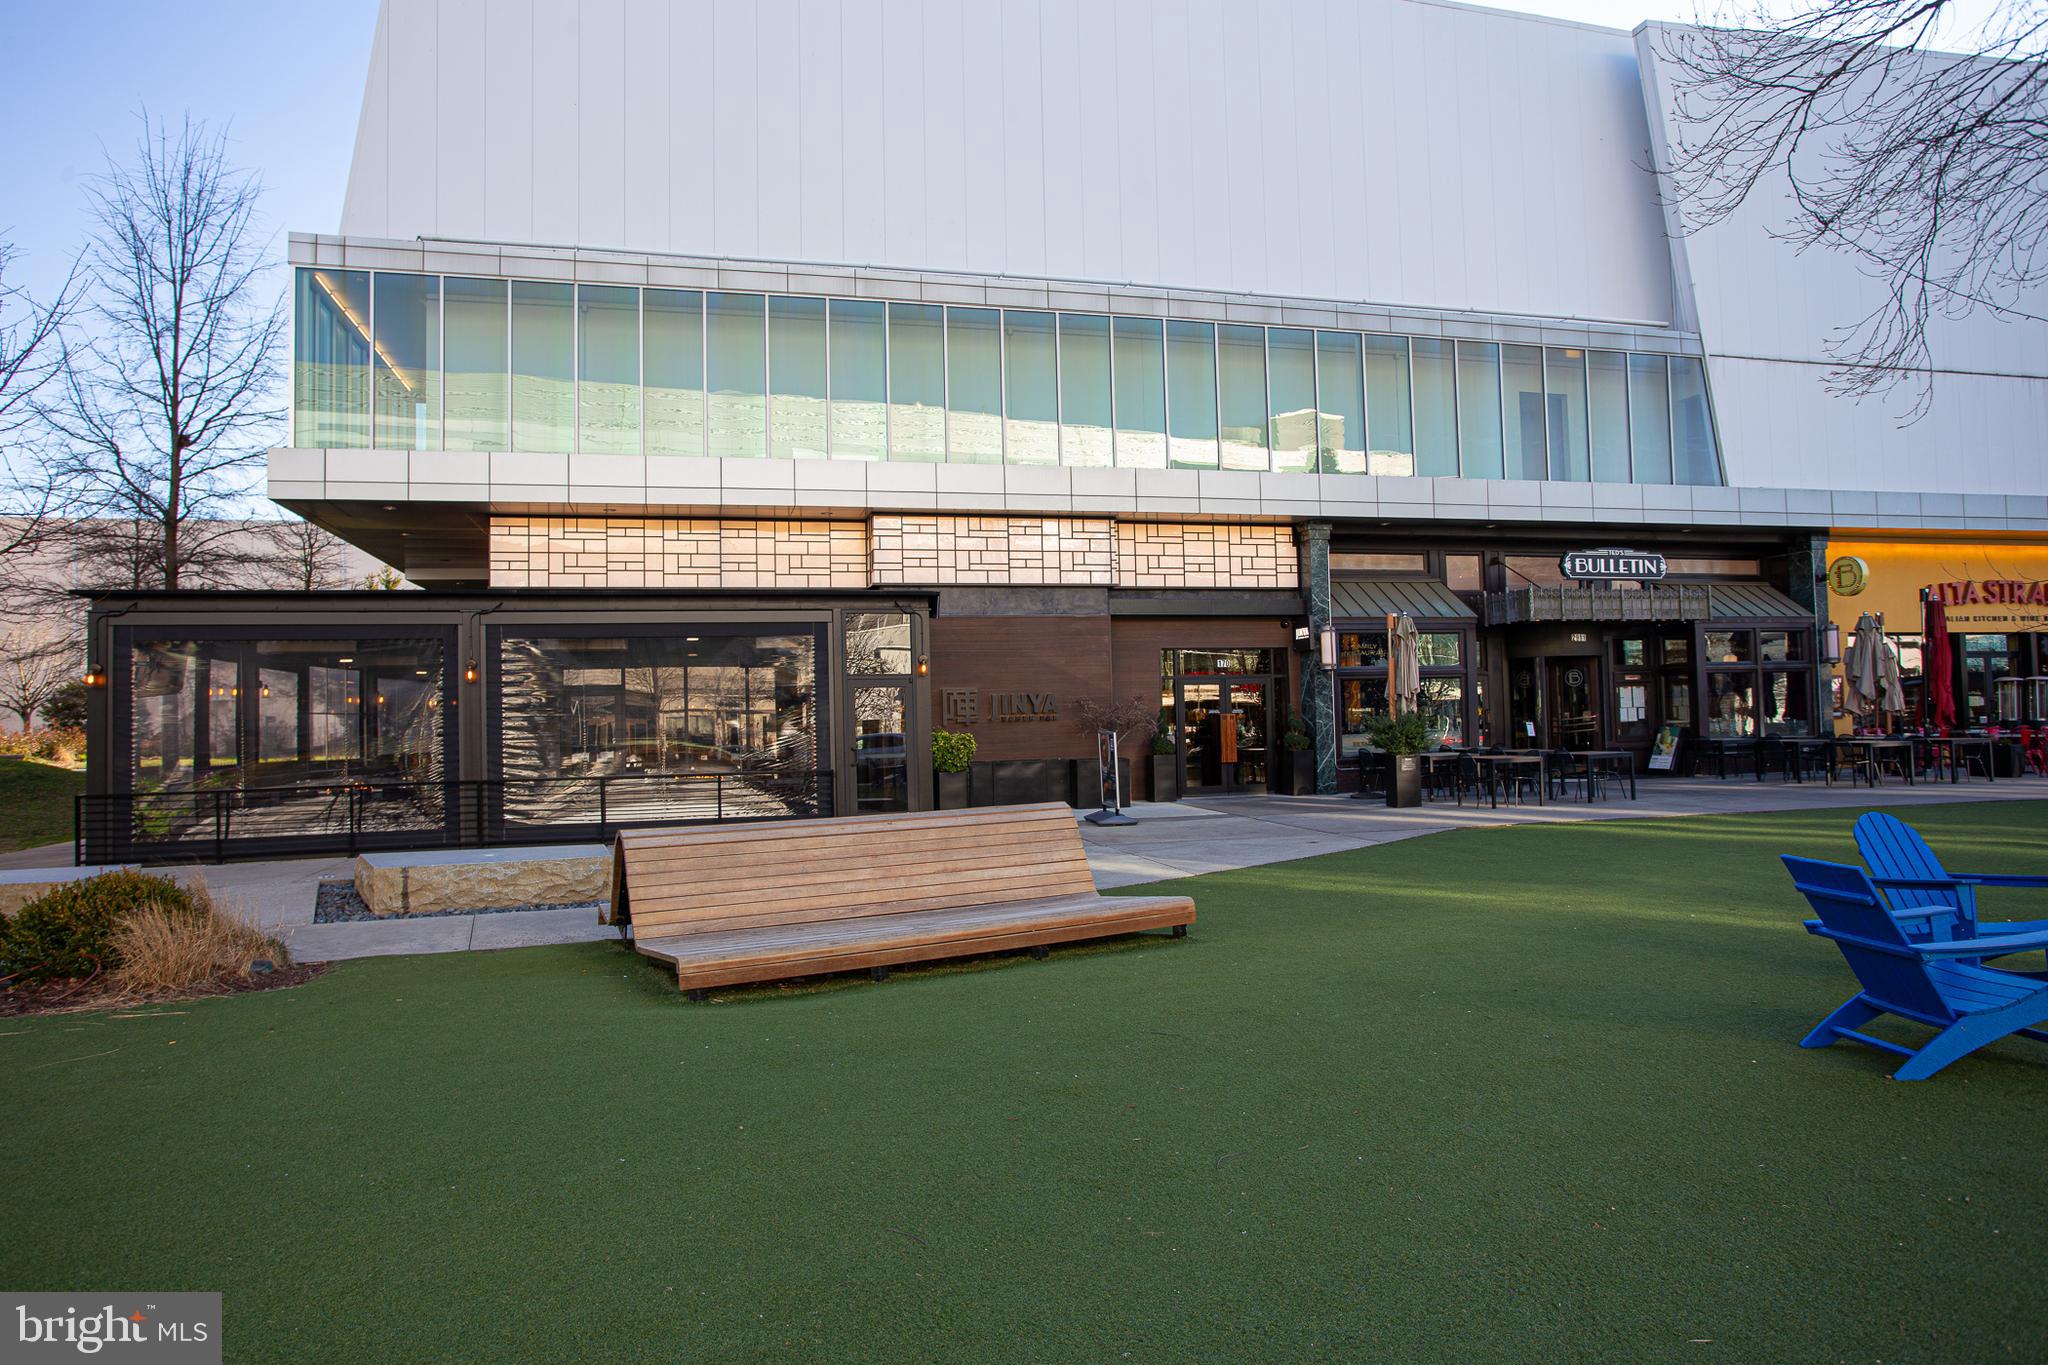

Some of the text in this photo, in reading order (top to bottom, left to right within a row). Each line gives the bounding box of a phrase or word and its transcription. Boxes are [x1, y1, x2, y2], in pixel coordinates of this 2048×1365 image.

[1574, 558, 1657, 574] BULLETIN
[1928, 580, 2048, 606] ALTA STRA
[1217, 659, 1231, 668] 170
[986, 693, 1057, 721] JINYA
